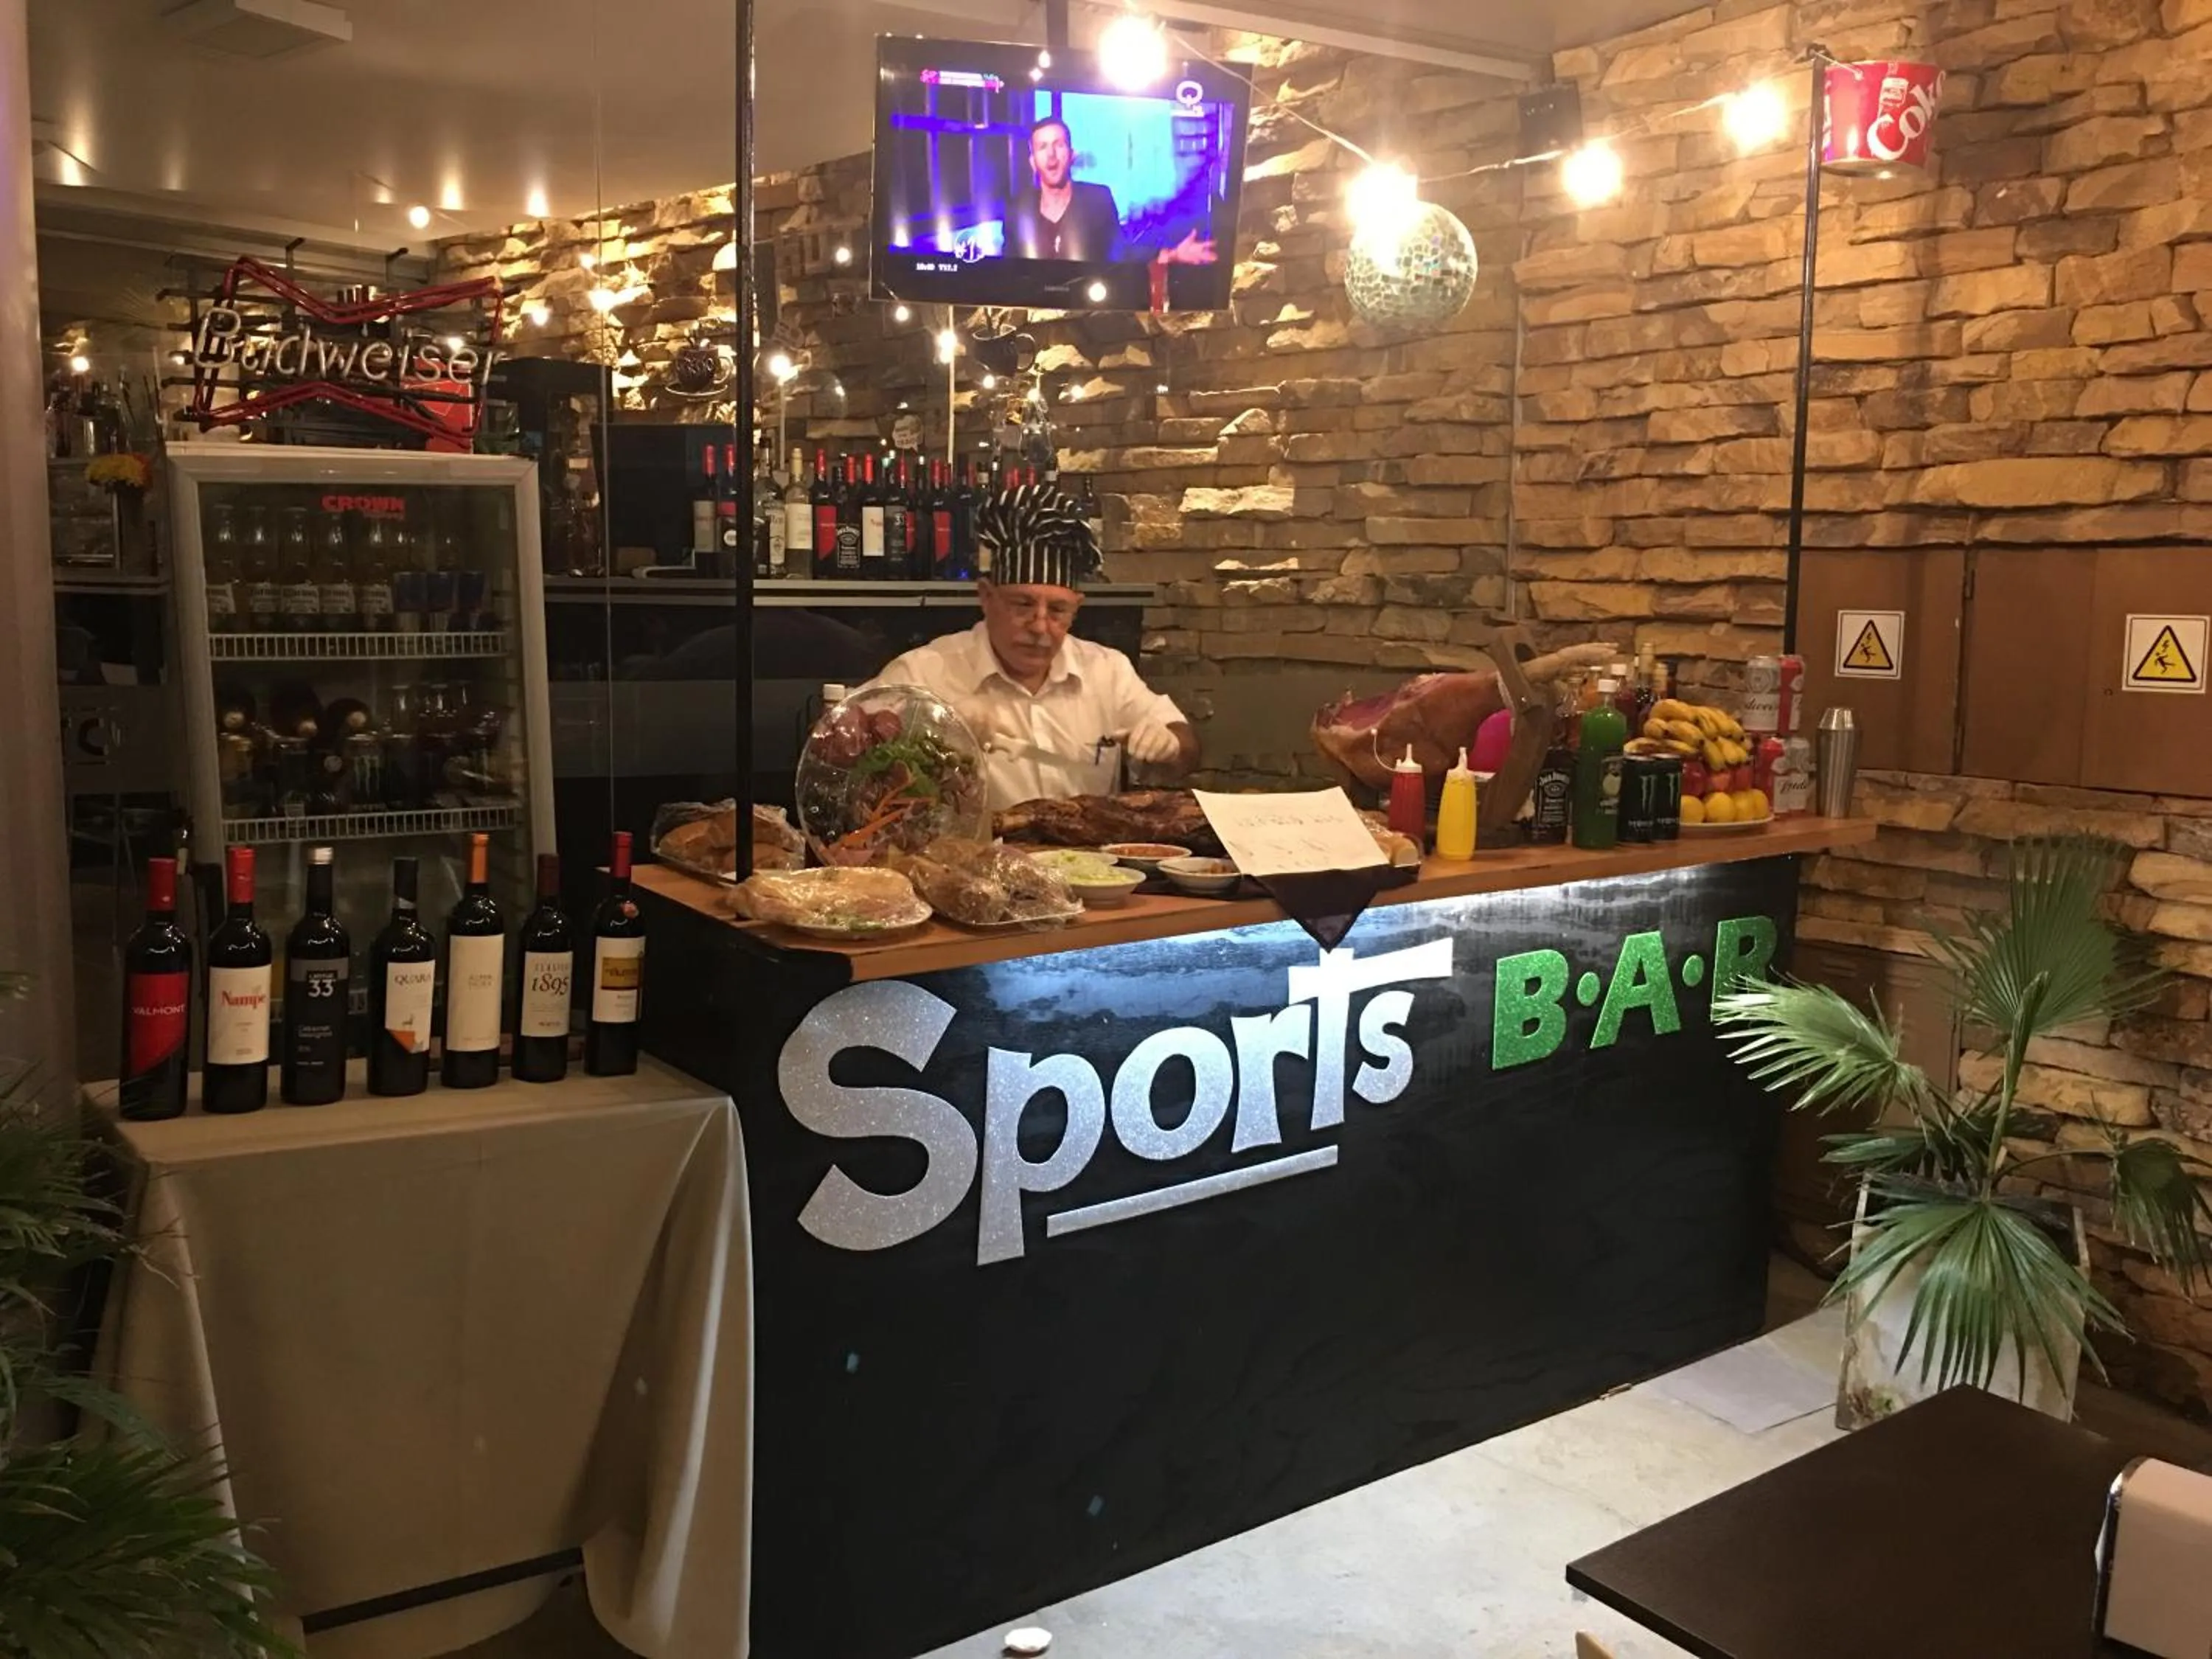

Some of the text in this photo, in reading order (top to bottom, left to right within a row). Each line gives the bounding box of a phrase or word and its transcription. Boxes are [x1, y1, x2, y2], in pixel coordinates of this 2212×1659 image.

[194, 307, 507, 386] Budweiser
[321, 495, 406, 512] CROWN
[307, 978, 335, 998] 33
[532, 972, 569, 996] 1895
[131, 1004, 185, 1016] VALMONT
[221, 990, 267, 1010] Nampe
